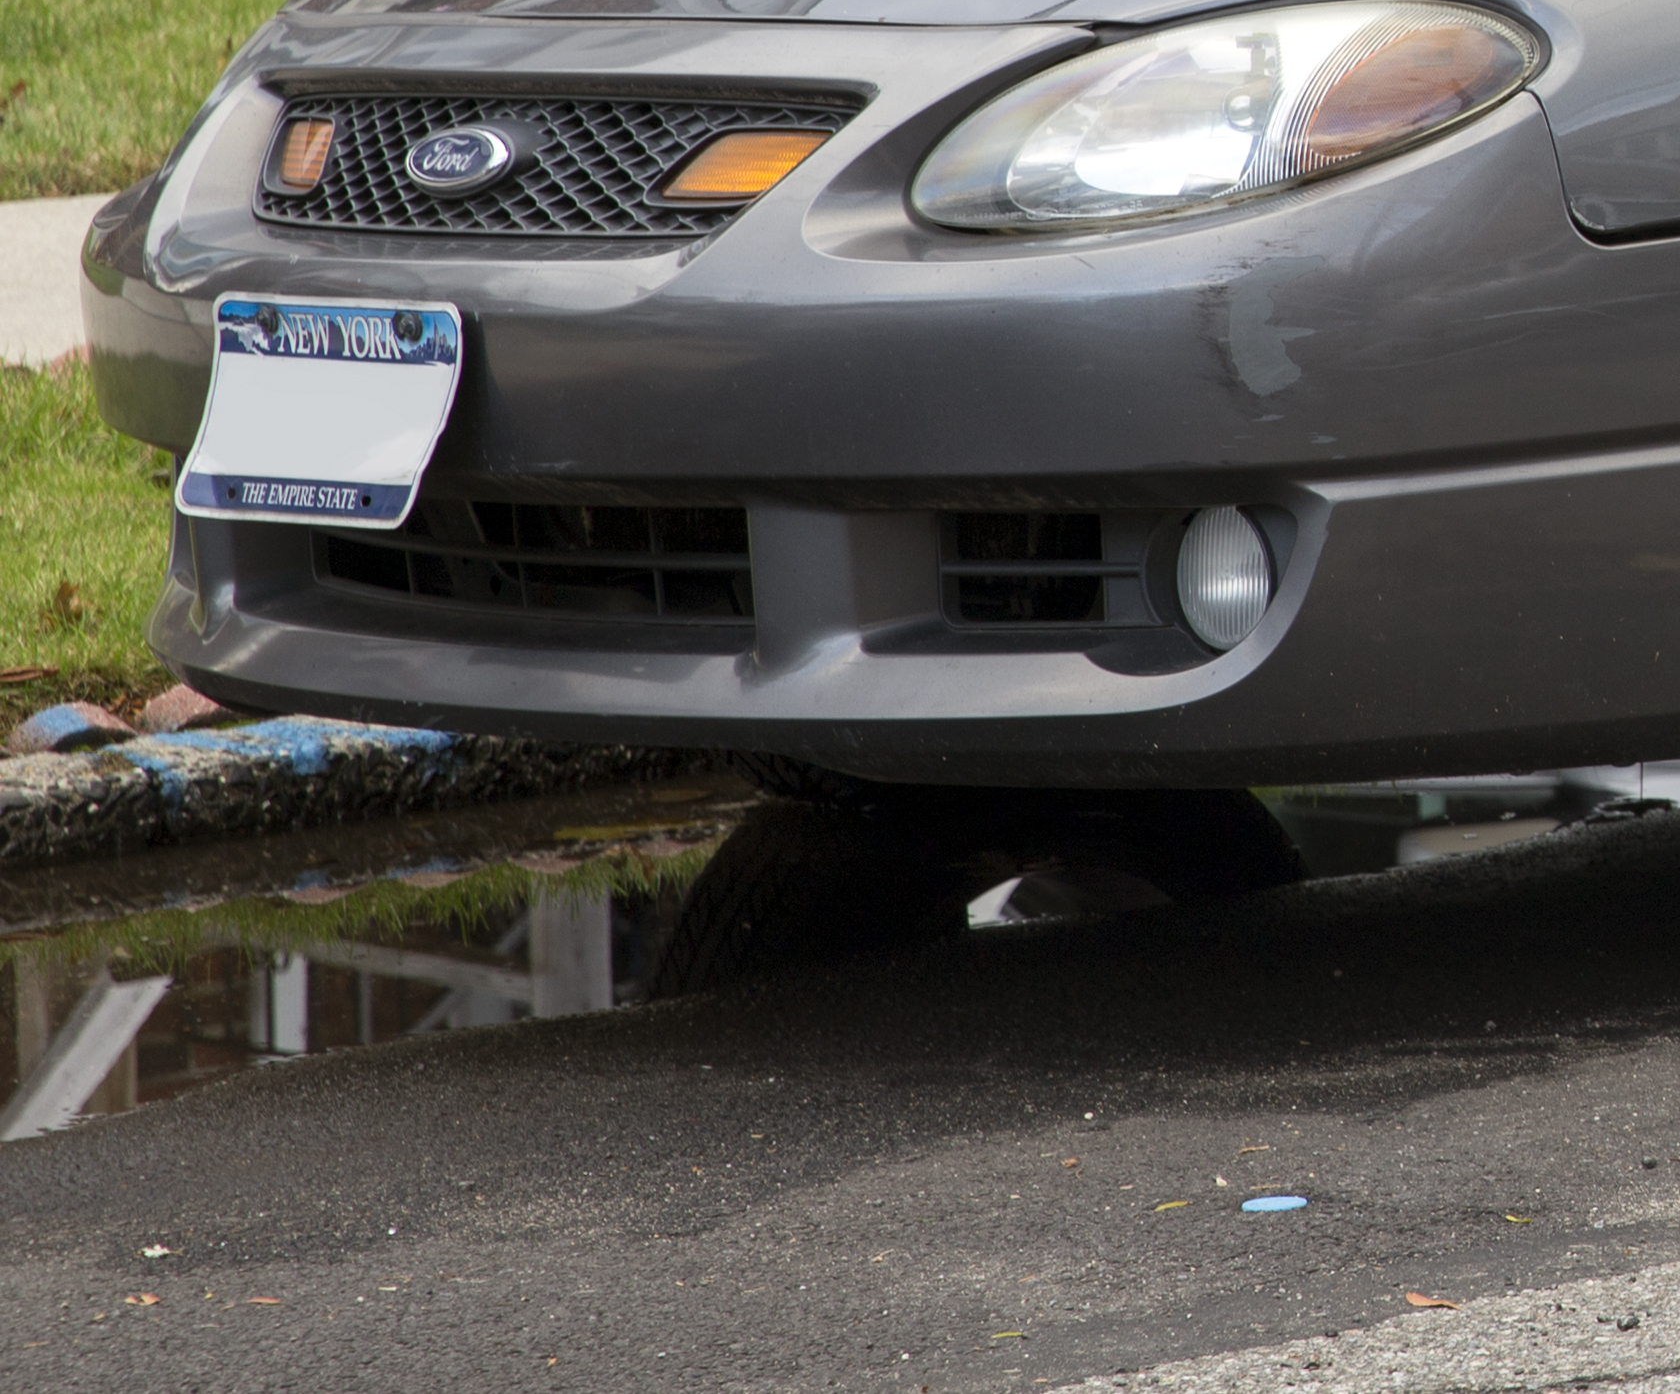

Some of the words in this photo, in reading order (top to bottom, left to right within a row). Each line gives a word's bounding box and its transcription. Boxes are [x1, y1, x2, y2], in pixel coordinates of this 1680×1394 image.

[422, 137, 479, 172] Ford
[278, 312, 331, 356] NEW
[337, 315, 402, 360] YORK
[241, 482, 268, 504] THE
[267, 483, 317, 507] EMPIRE
[317, 486, 358, 510] STATE
